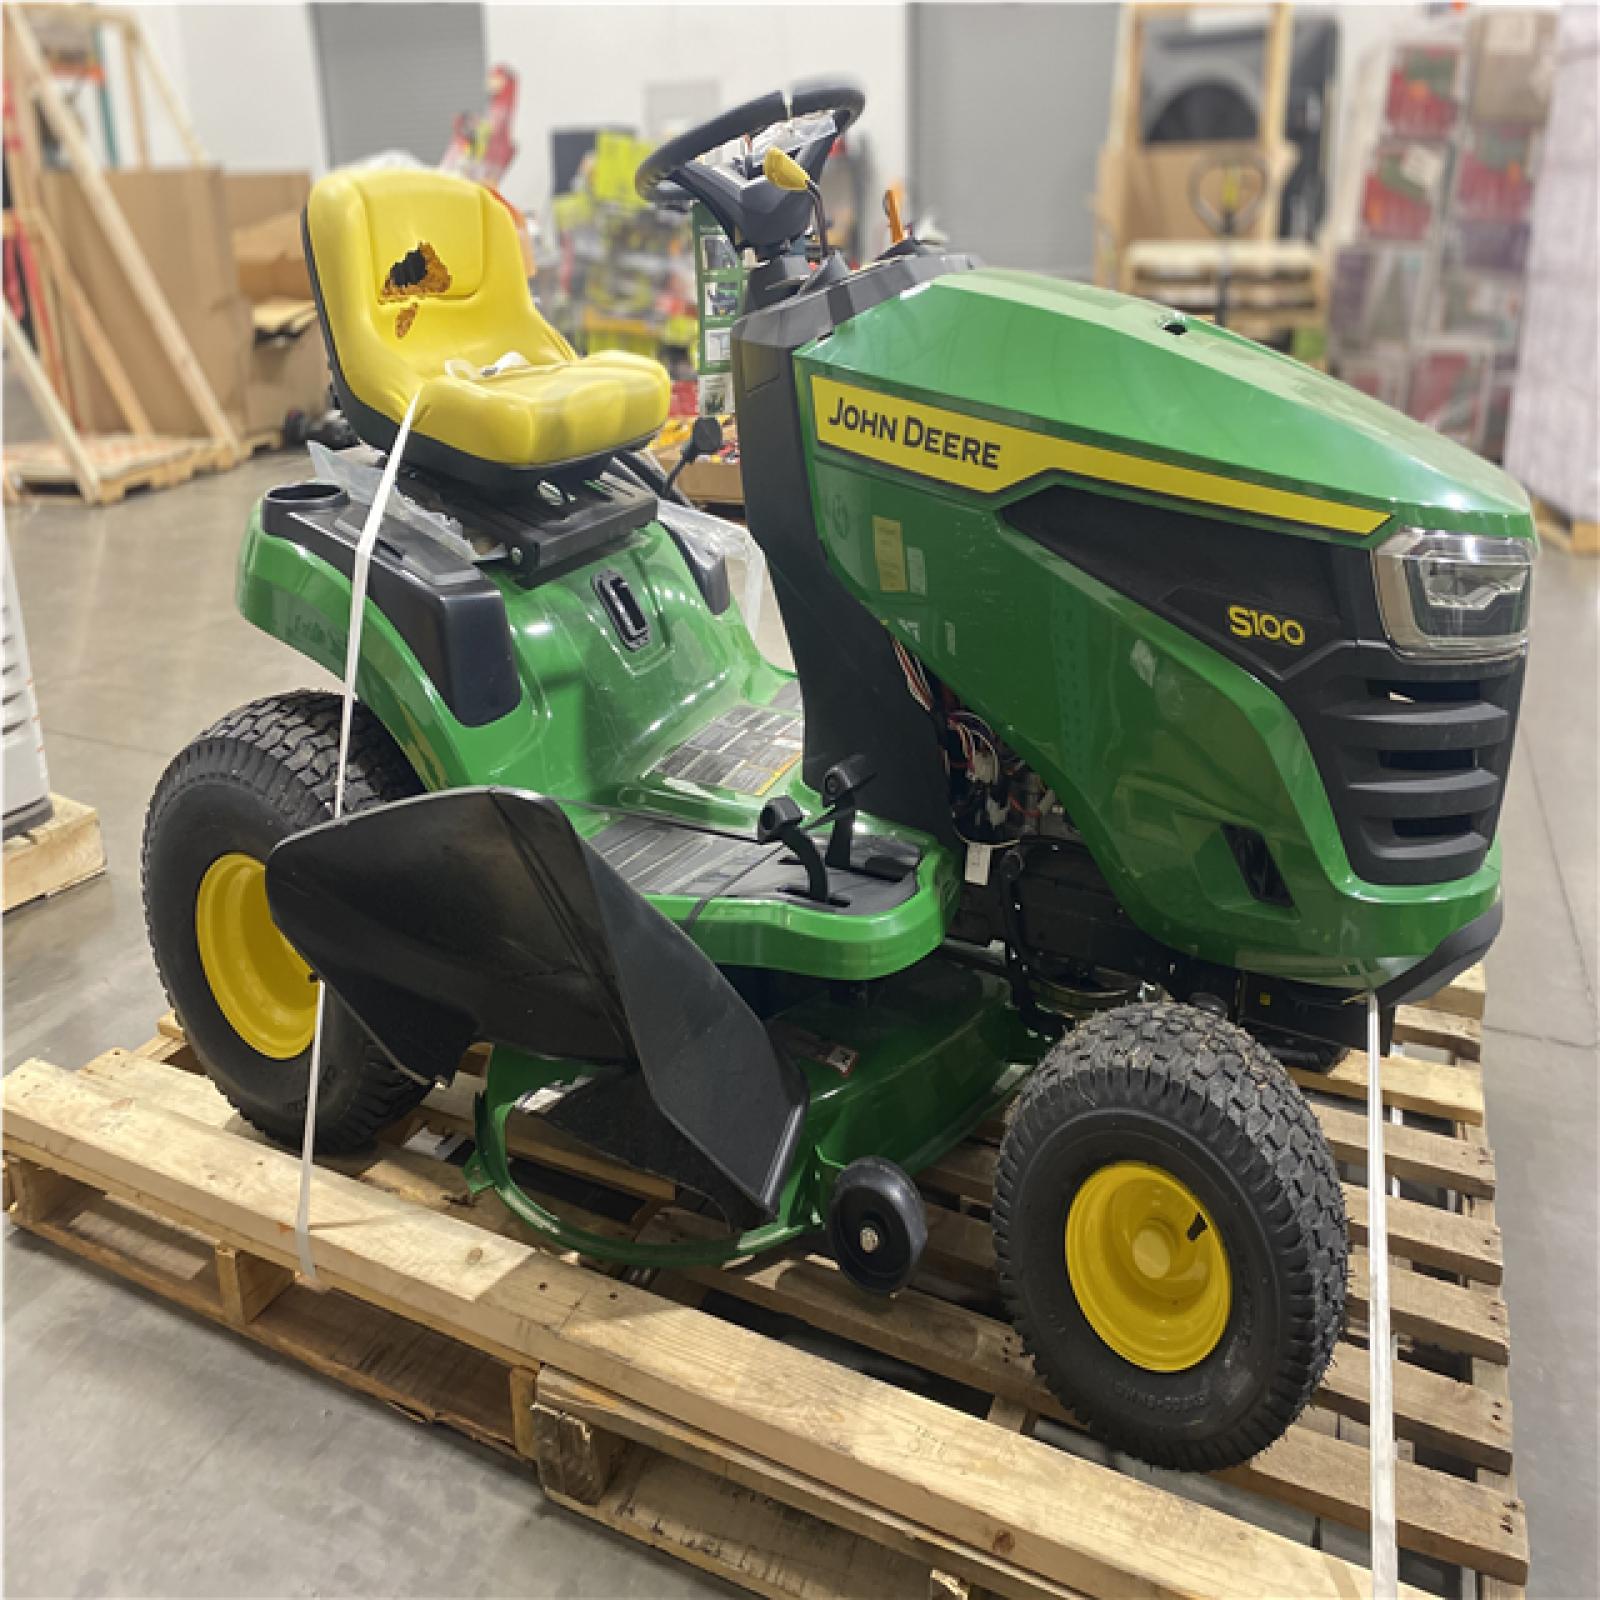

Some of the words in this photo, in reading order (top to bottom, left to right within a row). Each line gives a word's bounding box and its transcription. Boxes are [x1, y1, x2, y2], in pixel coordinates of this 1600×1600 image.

[828, 397, 898, 442] JOHN
[903, 415, 1001, 470] DEERE
[1228, 604, 1306, 646] S100
